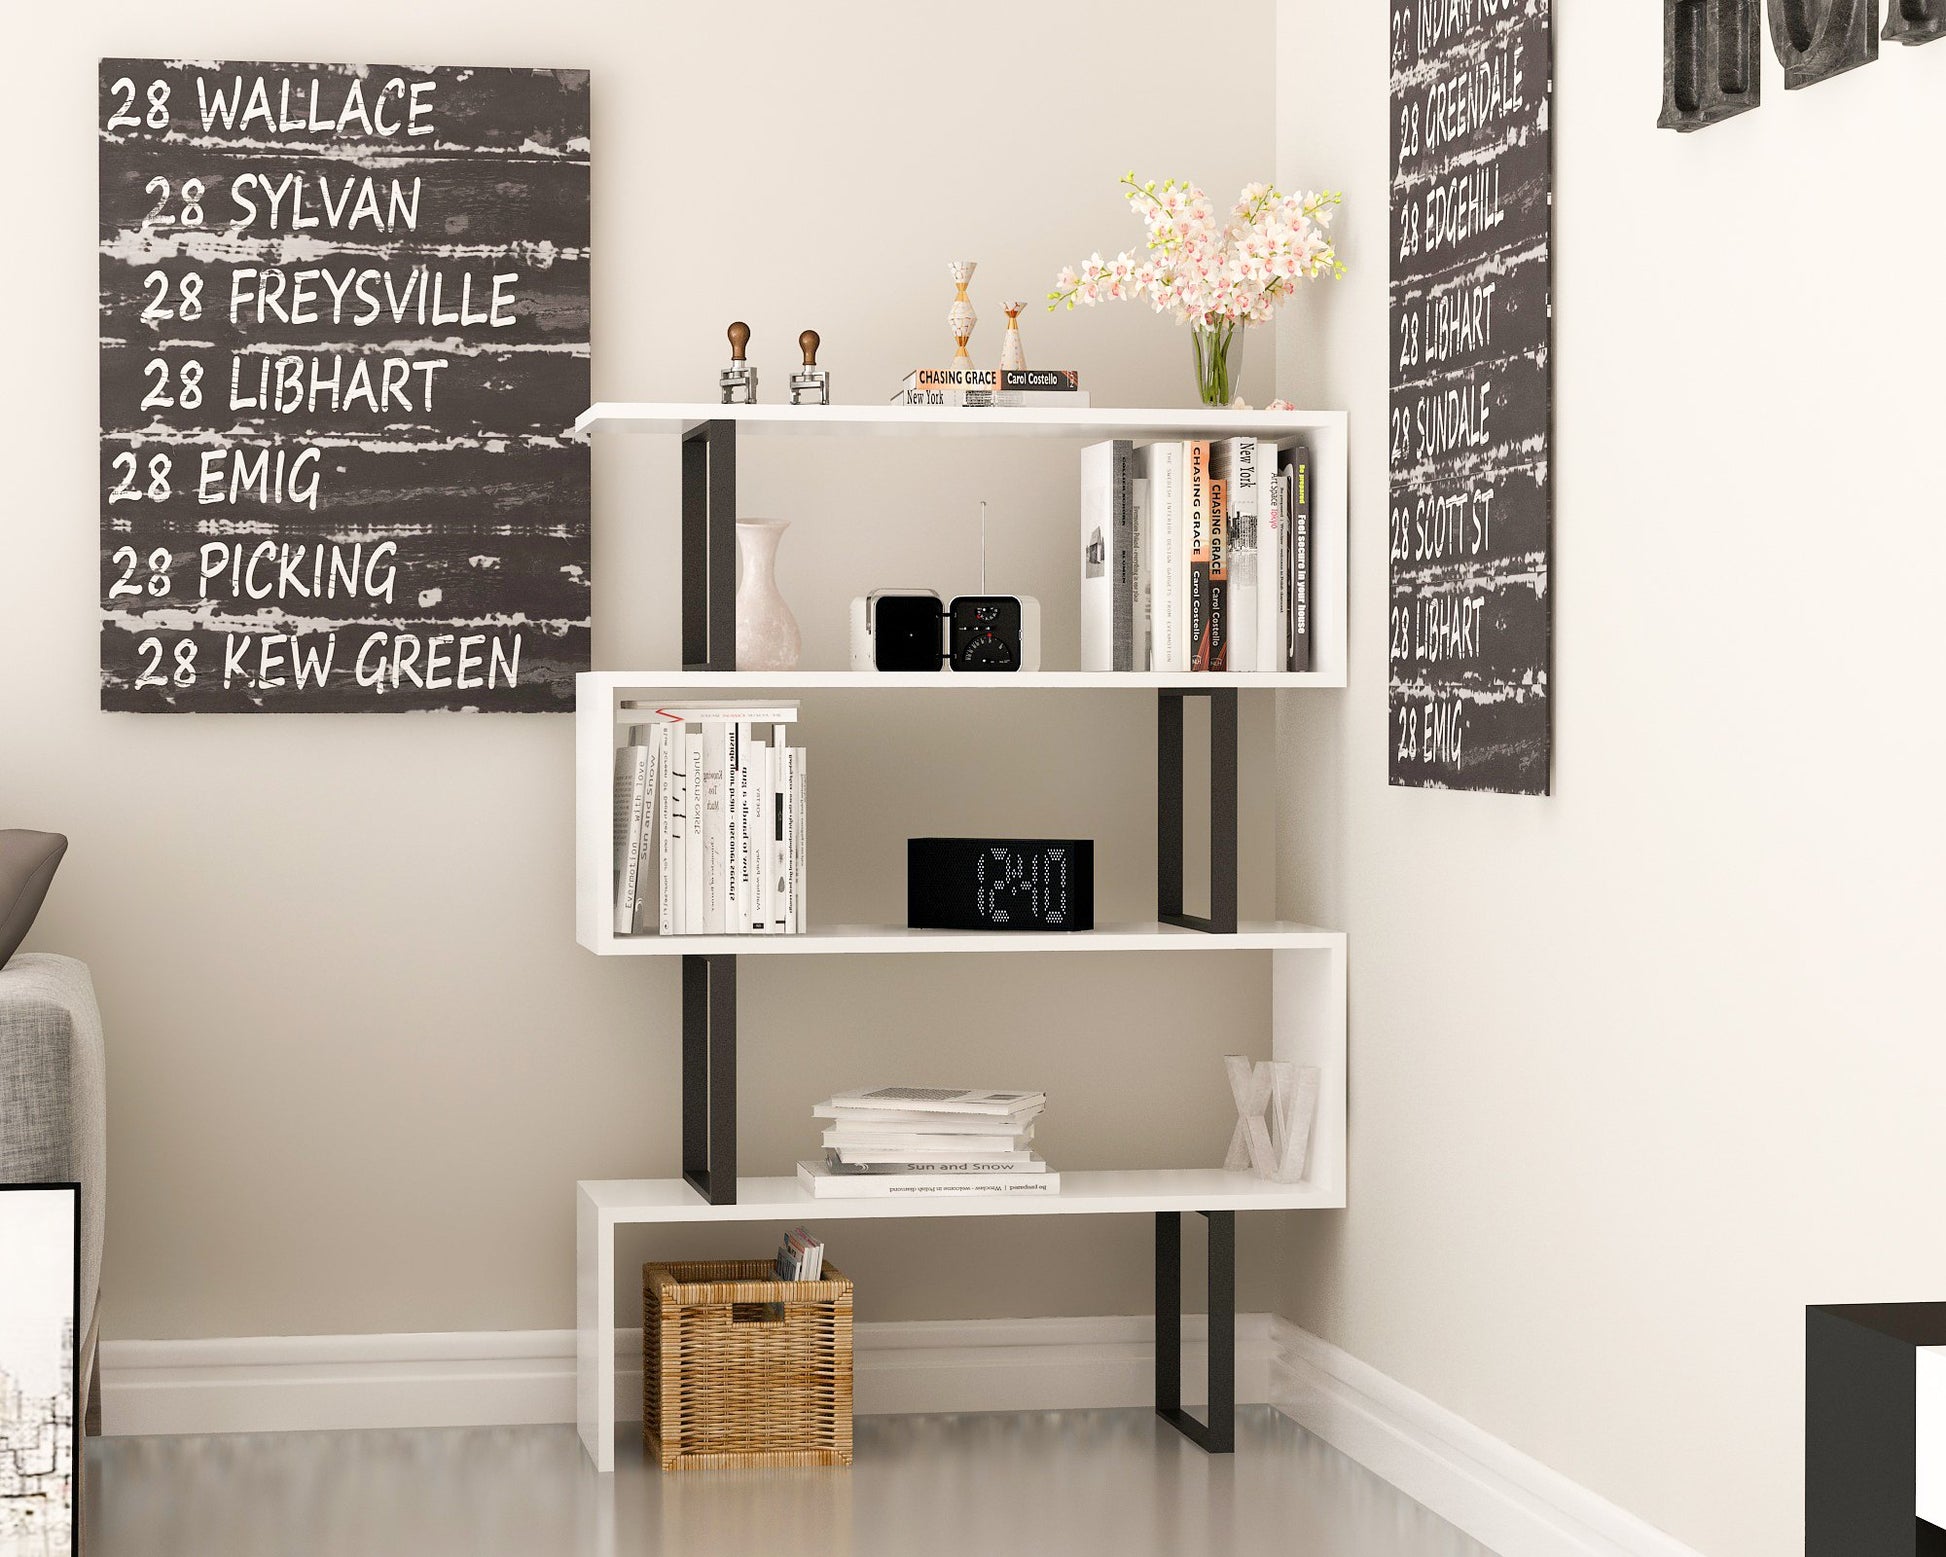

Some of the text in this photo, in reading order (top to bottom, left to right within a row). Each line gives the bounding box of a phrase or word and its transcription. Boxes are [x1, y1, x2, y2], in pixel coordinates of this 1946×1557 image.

[107, 75, 437, 136] 28 WALLACE
[1400, 46, 1524, 164] 28 GREENDALE
[142, 173, 420, 232] 28 SYLVAN
[1399, 163, 1505, 263] 28 EDGEHILL
[140, 268, 519, 327] 28 FREYSVILLE
[1400, 282, 1496, 372] 28 LIBHART
[140, 354, 449, 414] 28 LIBHART
[907, 390, 944, 406] New York
[919, 370, 997, 385] CHASING GRACE
[1007, 372, 1027, 385] Carol
[1028, 372, 1058, 385] Costello
[1391, 381, 1491, 464] 28 SUNDALE
[108, 448, 321, 511] 28 EMIG
[1239, 443, 1256, 488] New York
[1299, 464, 1306, 474] Be
[1193, 446, 1201, 556] CHASING GRACE
[1269, 510, 1278, 529] Tokyo
[1270, 486, 1278, 506] Space
[1298, 514, 1306, 535] Feel
[1212, 484, 1221, 575] CHASING GRACE
[1298, 536, 1306, 570] secure
[1391, 488, 1494, 564] 28 SCOTT ST
[108, 540, 398, 604] 28 PICKING
[1297, 581, 1306, 604] your
[1212, 587, 1220, 646] Carol Costello
[1298, 604, 1306, 634] house
[1390, 595, 1485, 663] 28 LIBHART
[134, 631, 522, 694] 28 KEW GREEN
[1398, 699, 1462, 771] 28 EMIG
[647, 755, 656, 796] Snow
[625, 842, 638, 908] Evermotion
[636, 762, 644, 786] love
[907, 1162, 1015, 1171] Sun and Snow
